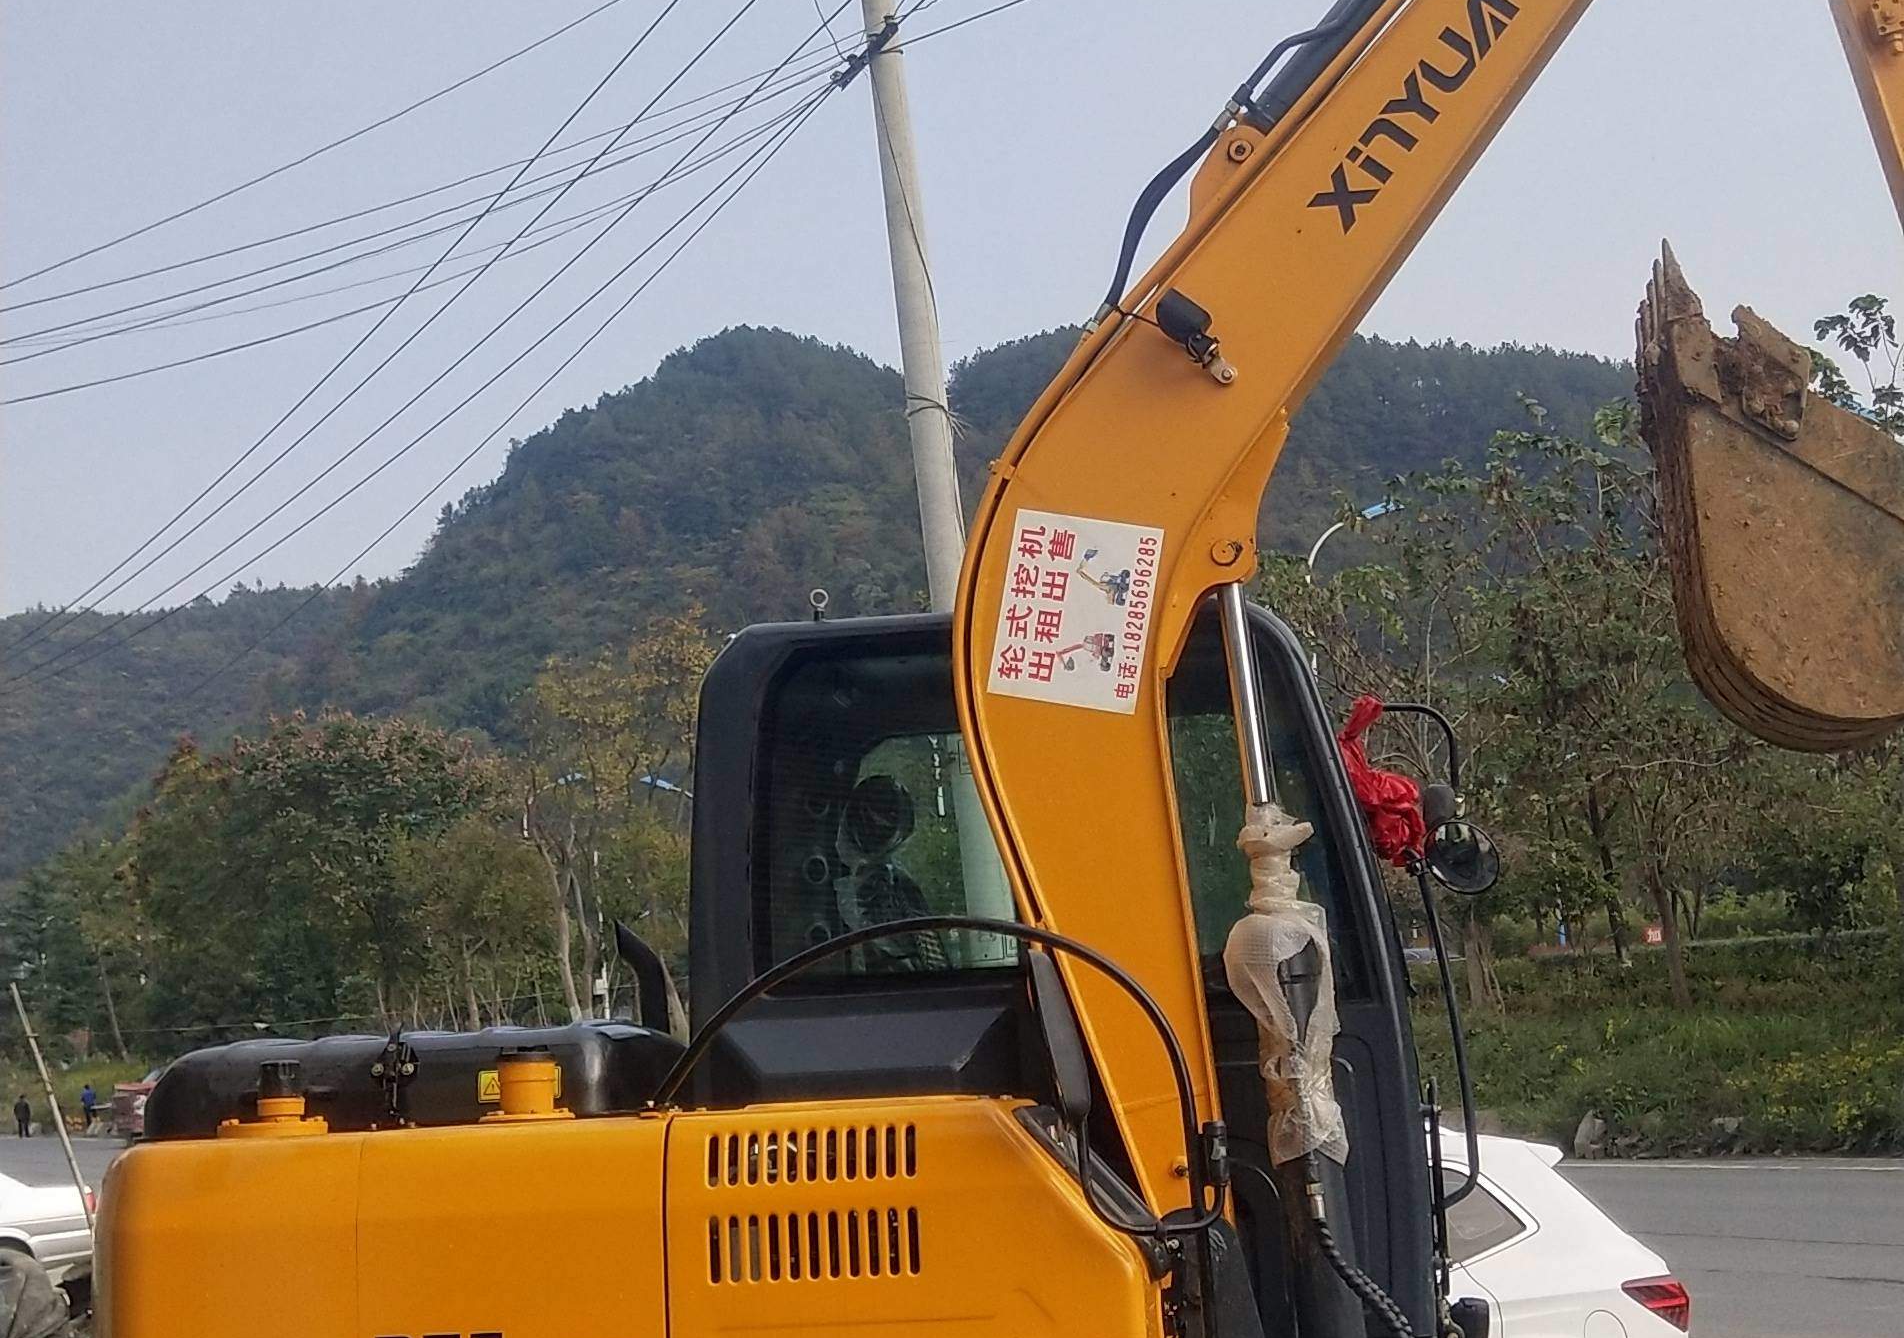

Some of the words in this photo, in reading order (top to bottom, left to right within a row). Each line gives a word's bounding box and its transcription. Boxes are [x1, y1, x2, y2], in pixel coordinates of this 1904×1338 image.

[997, 525, 1047, 680] 轮式挖机
[1028, 528, 1079, 683] 出租出售
[1113, 536, 1158, 700] 电话:18285696285
